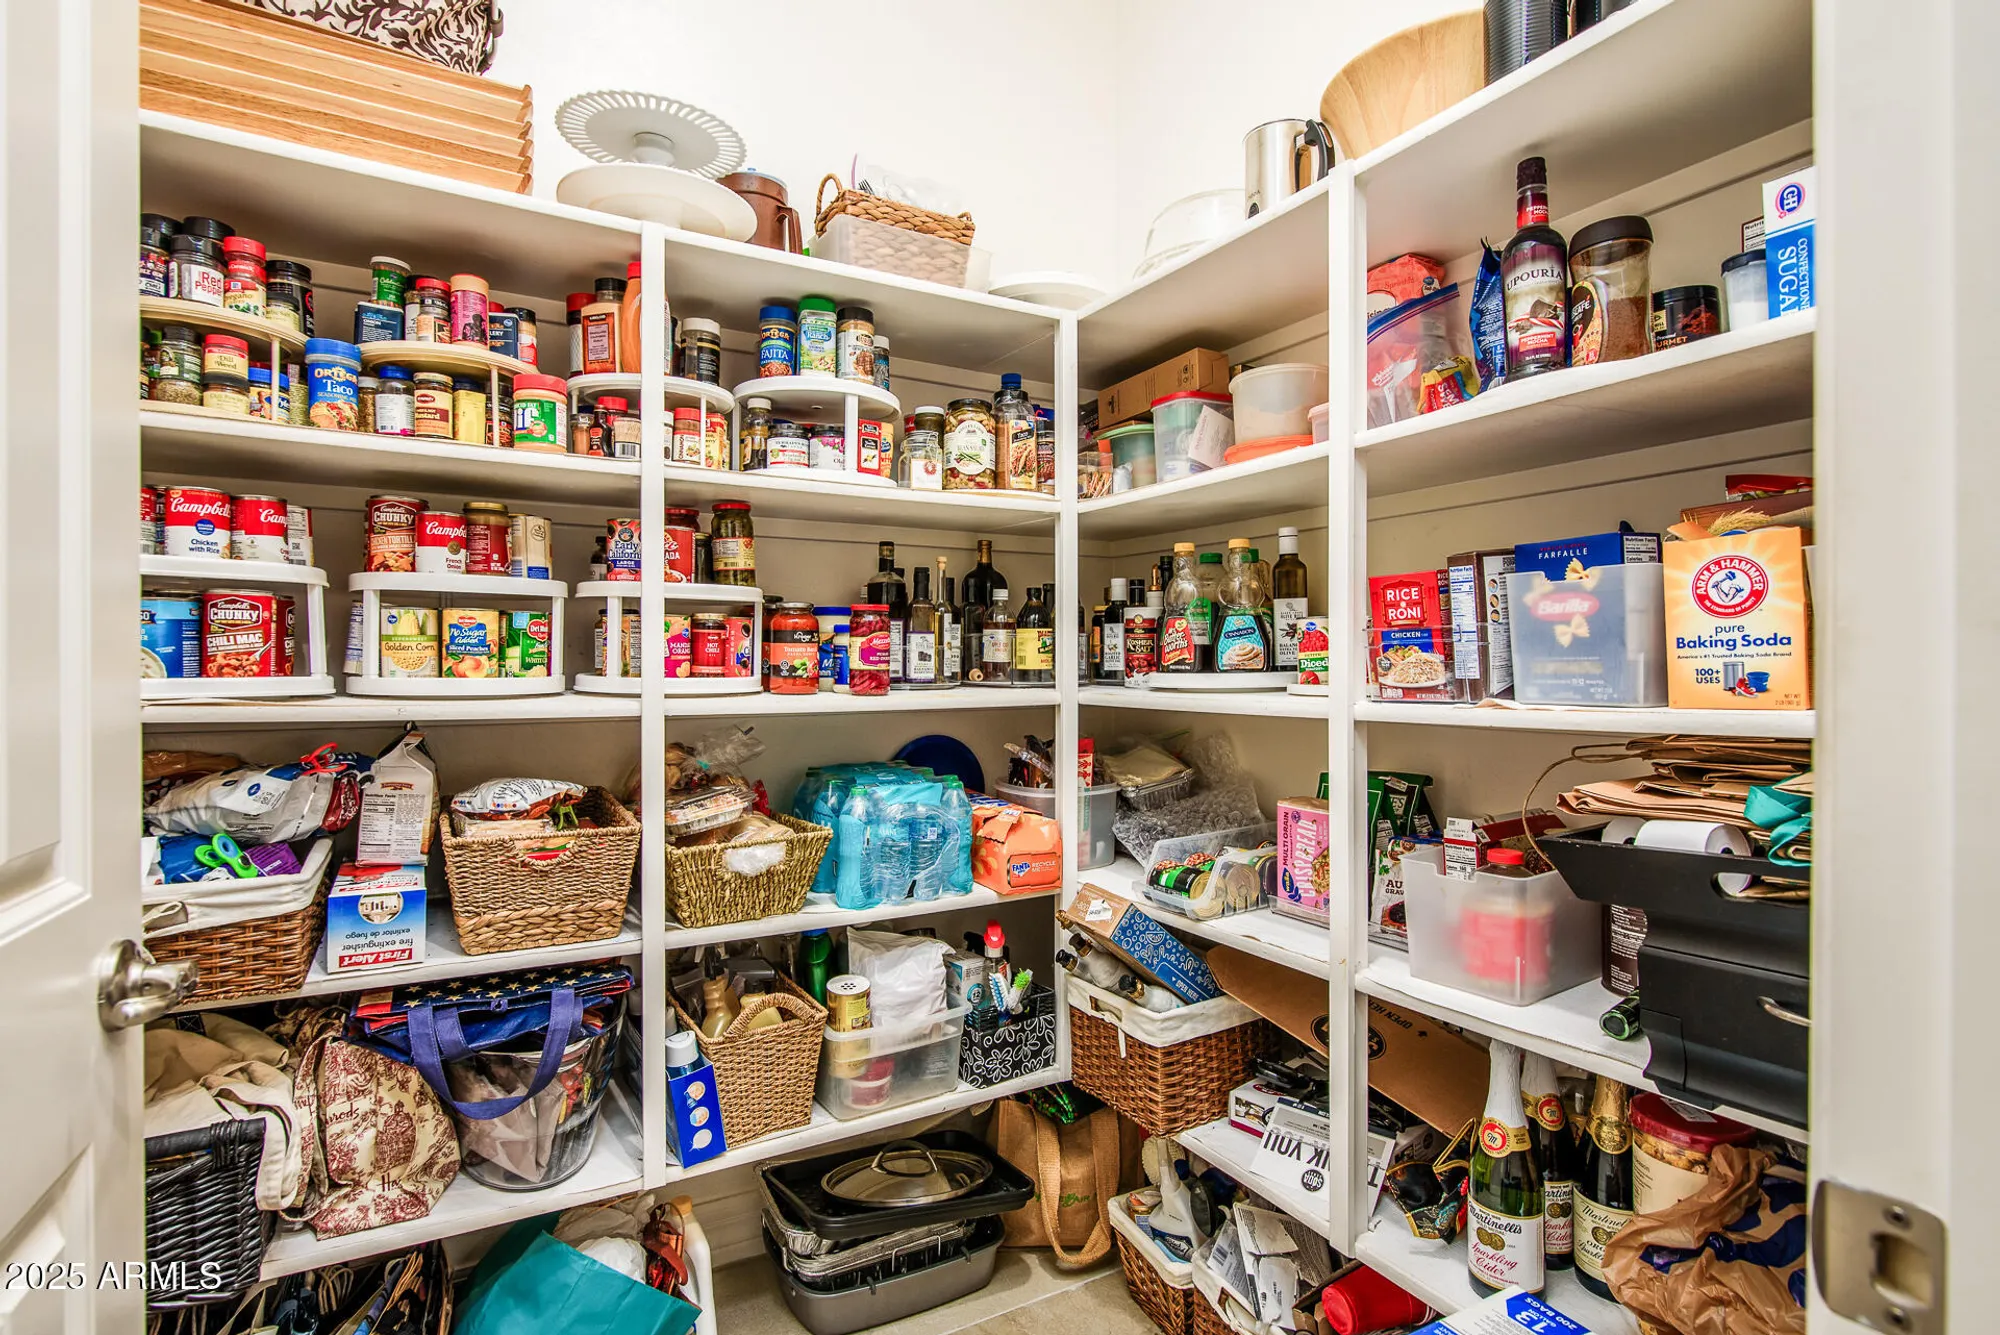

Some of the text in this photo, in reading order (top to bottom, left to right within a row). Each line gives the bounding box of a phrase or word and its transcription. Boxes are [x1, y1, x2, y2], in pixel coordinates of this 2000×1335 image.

[761, 348, 789, 360] FAJITA
[314, 368, 358, 384] ORTEGA
[323, 379, 354, 396] Taco
[374, 511, 414, 524] CHUNKY
[190, 538, 218, 547] Chicken
[615, 541, 639, 552] Early
[188, 545, 220, 554] with Rice
[1538, 547, 1588, 560] FARFALLE
[1696, 559, 1764, 595] ARM & HAMMER
[1386, 587, 1419, 601] RICE
[210, 608, 258, 621] CHUNKY
[1388, 608, 1421, 620] RONI
[450, 628, 487, 640] No Sugar
[1224, 628, 1255, 638] CINNABON
[1391, 631, 1421, 639] CHICKEN
[1715, 625, 1745, 636] pure
[206, 632, 264, 648] CHILI MAC
[384, 642, 436, 651] Golden Corn
[455, 636, 480, 644] Added
[1676, 633, 1792, 651] Baking Soda
[1300, 659, 1329, 668] Diced
[1695, 668, 1721, 676] 100+
[345, 932, 368, 940] fuego
[382, 928, 411, 936] extintor
[342, 938, 413, 952] fire extinguisher
[341, 950, 410, 966] First Alert
[1384, 1011, 1413, 1030] OPEN
[1582, 1204, 1628, 1228] Martinel
[1471, 1241, 1518, 1270] Sparkling
[1475, 1257, 1506, 1277] Cider
[1525, 1297, 1578, 1330] 200 BAGS
